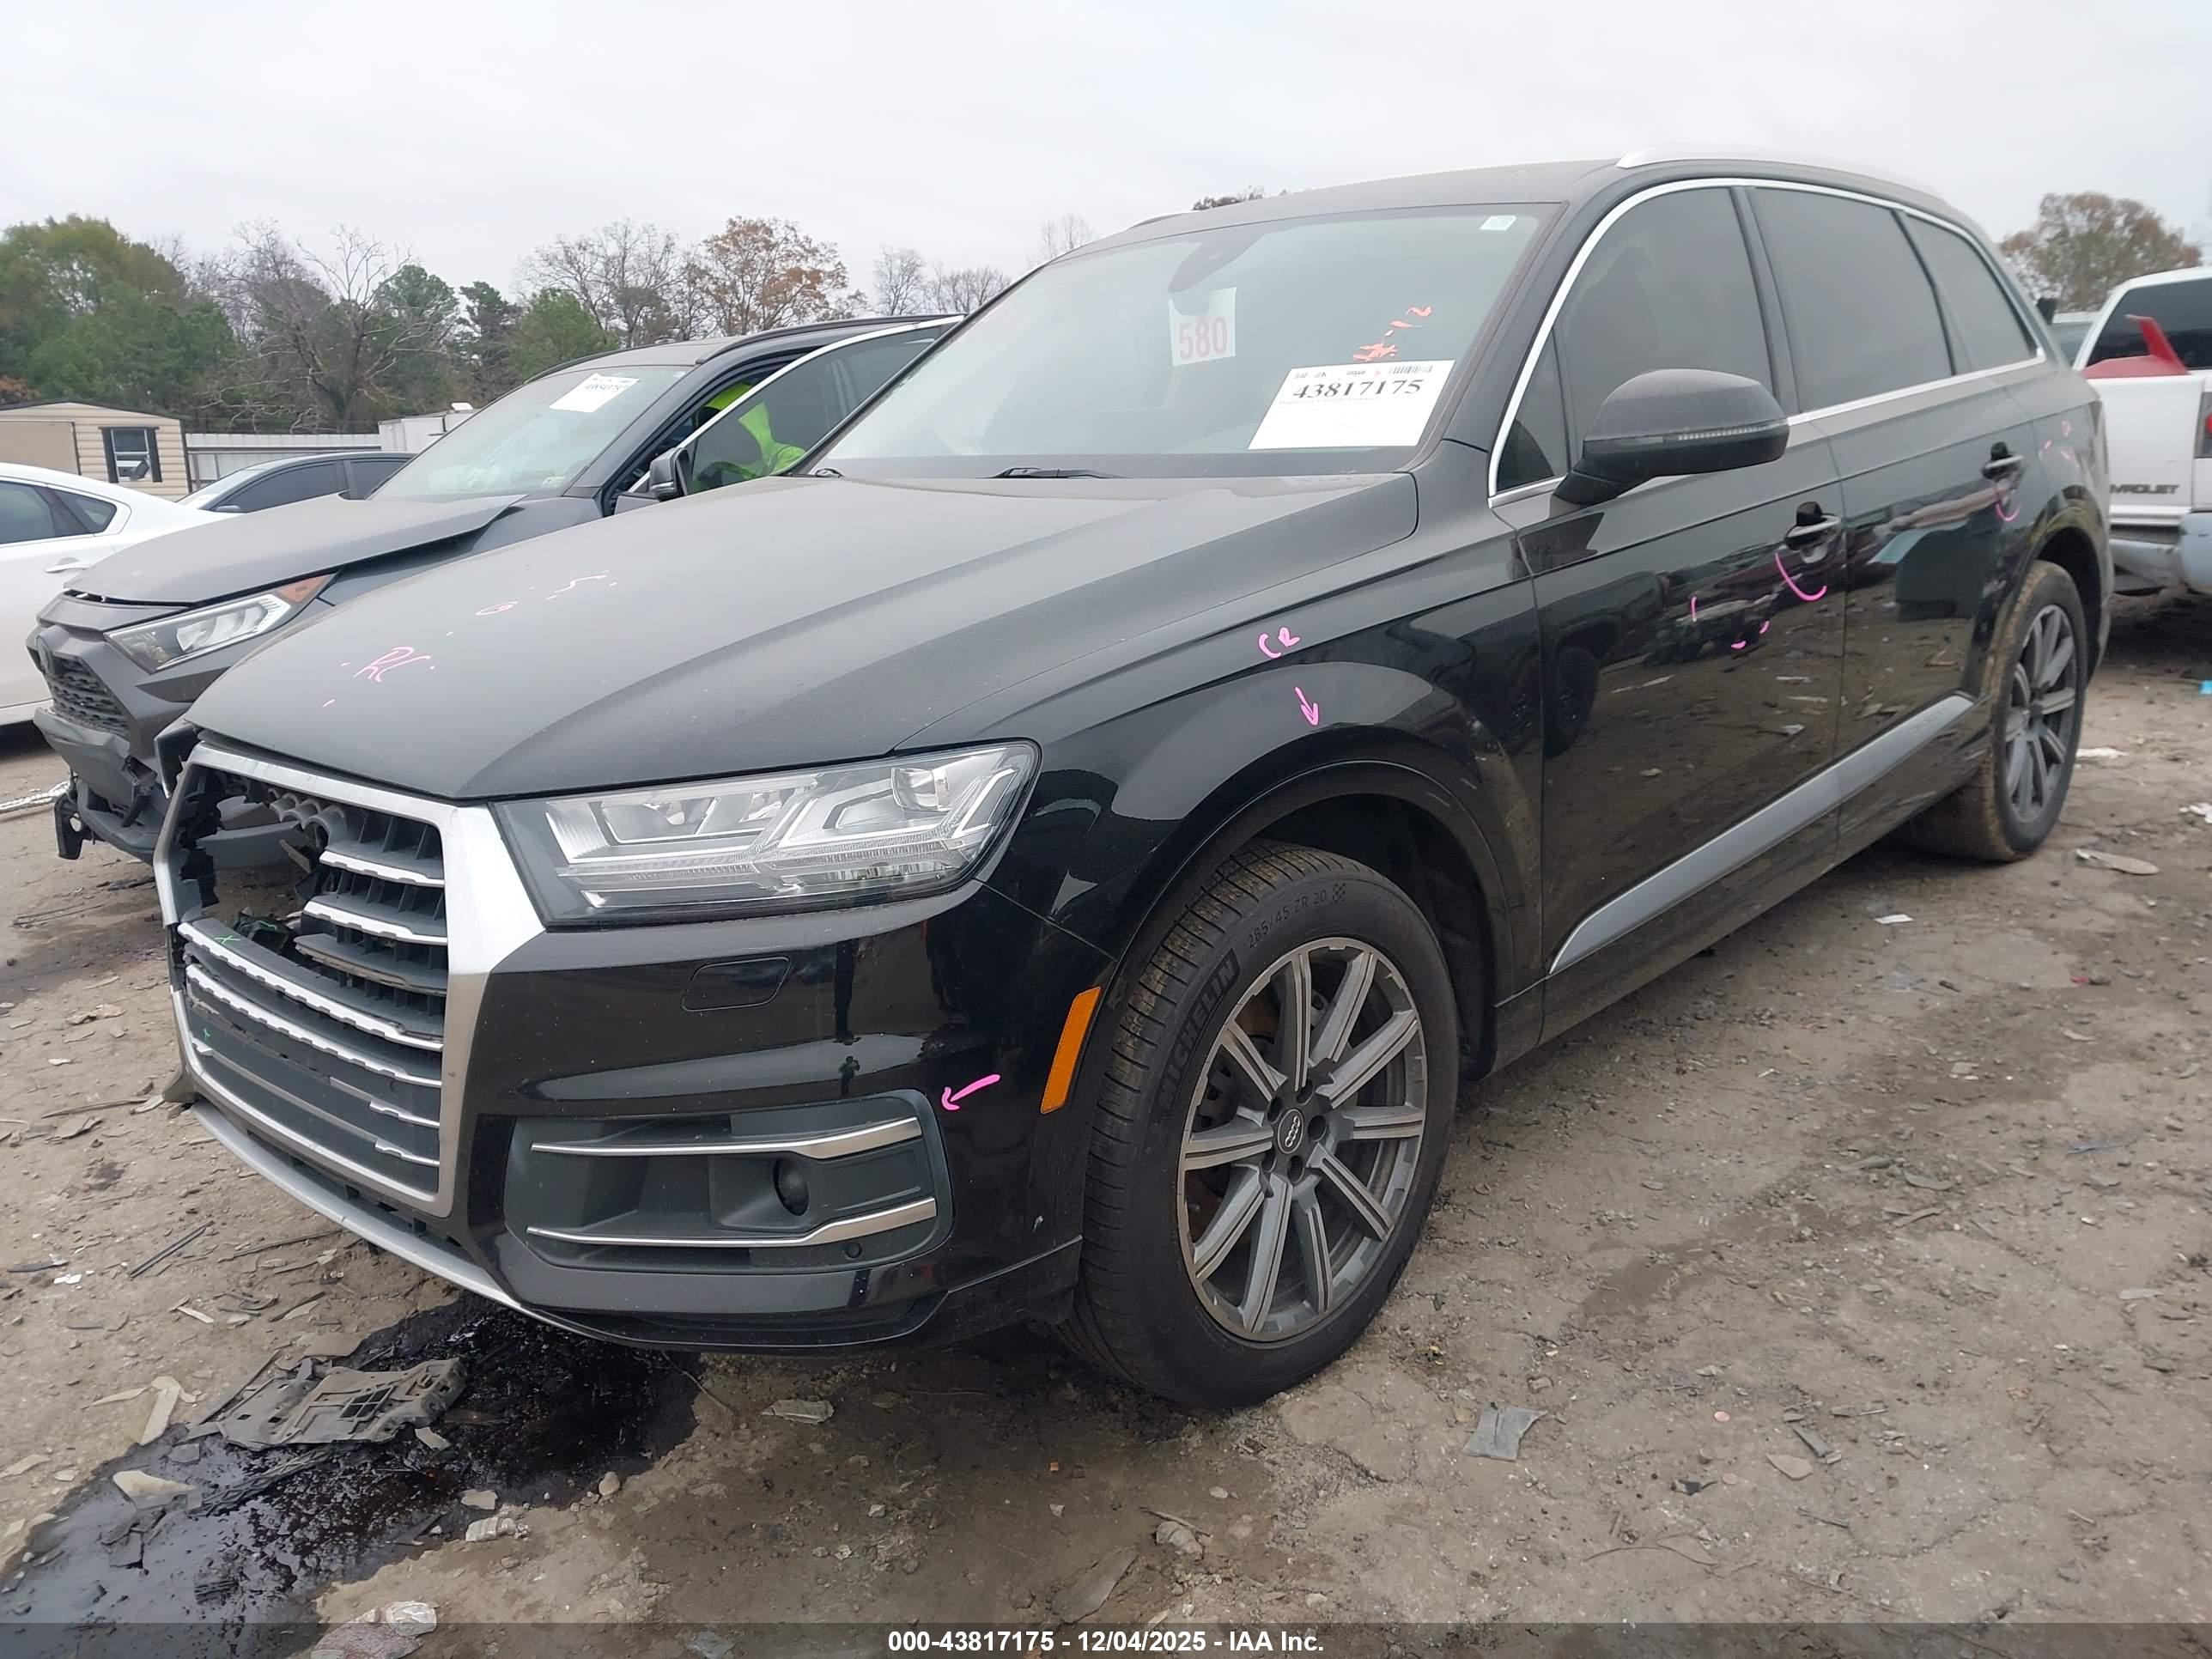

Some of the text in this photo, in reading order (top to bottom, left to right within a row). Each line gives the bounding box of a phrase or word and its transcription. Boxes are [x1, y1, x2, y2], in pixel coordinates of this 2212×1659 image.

[1179, 316, 1228, 360] 580
[1293, 379, 1424, 399] 43817175
[1293, 895, 1309, 914] ZR
[1313, 889, 1328, 905] 20
[1157, 951, 1239, 1103] MICHELIN
